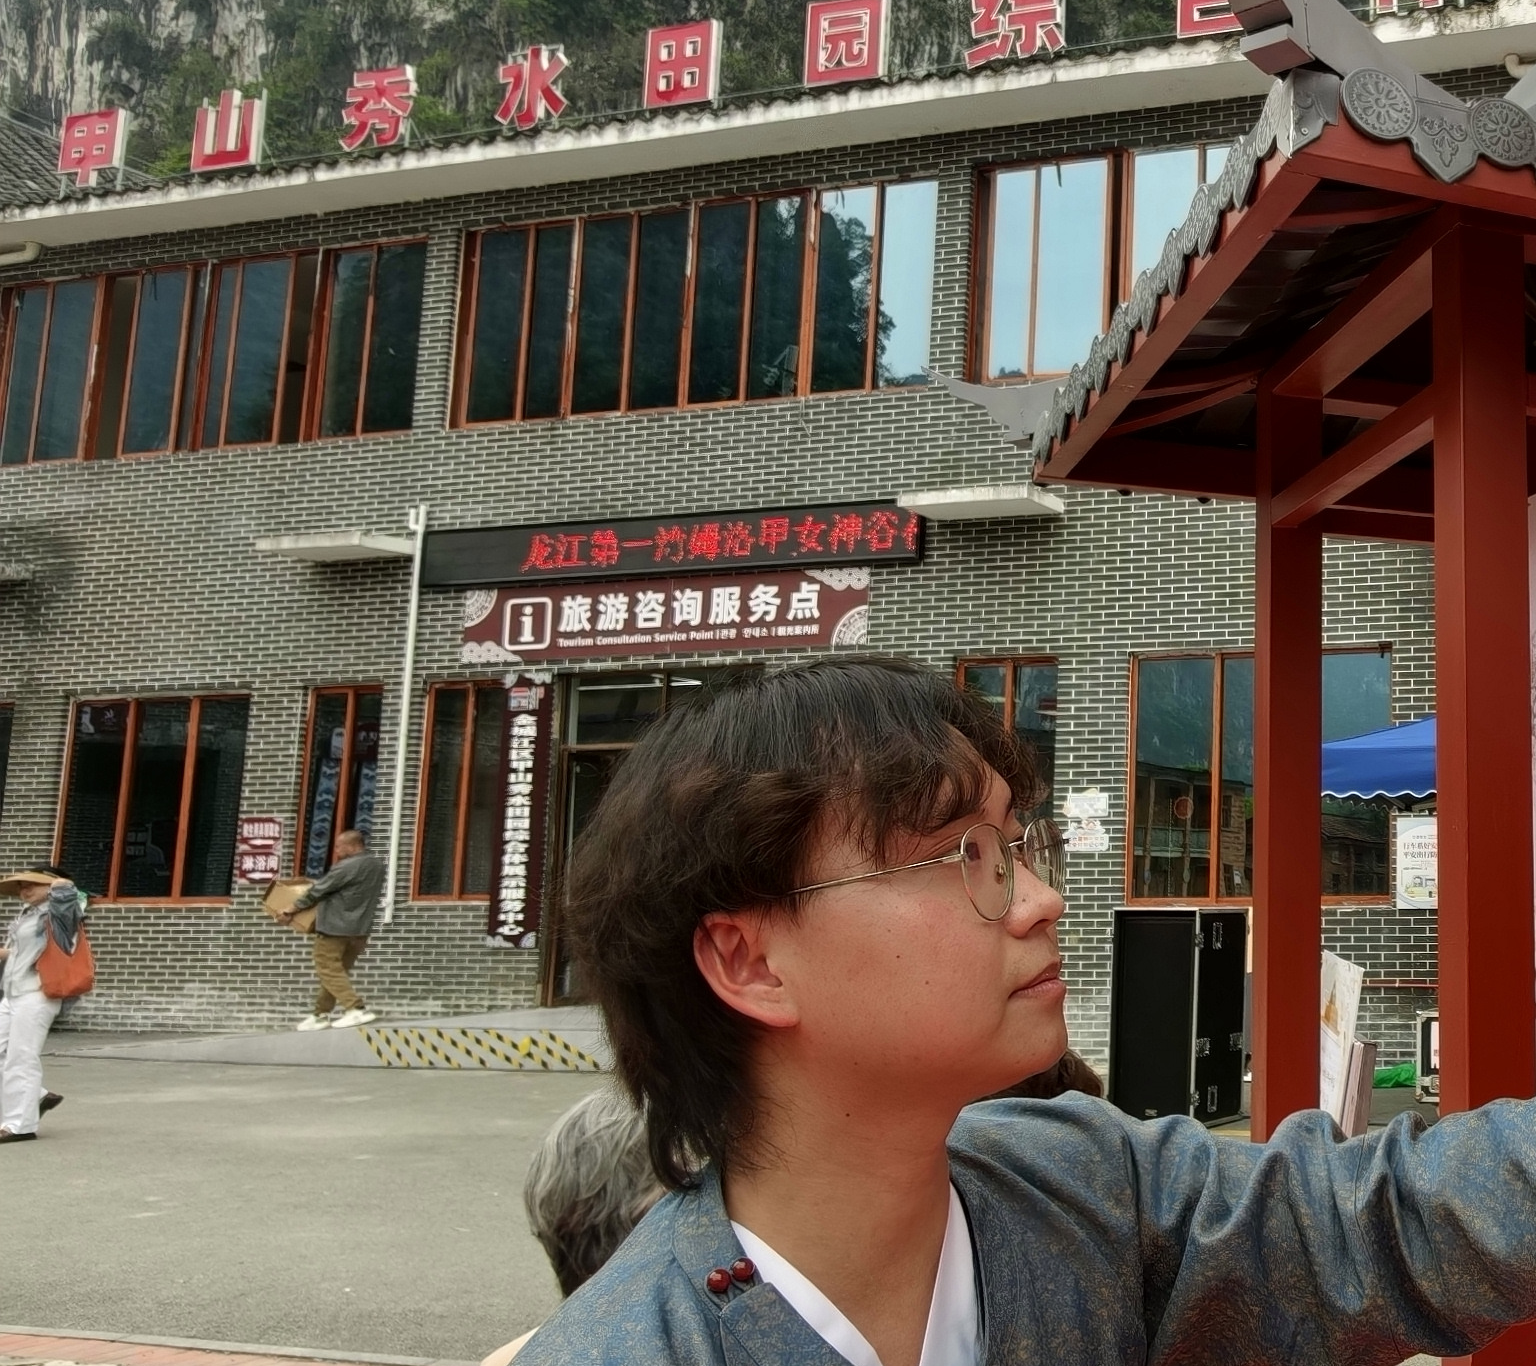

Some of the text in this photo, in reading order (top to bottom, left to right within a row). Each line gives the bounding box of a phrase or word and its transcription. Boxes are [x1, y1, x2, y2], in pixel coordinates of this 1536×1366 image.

[557, 581, 821, 633] 旅游咨询服务点
[557, 630, 714, 648] Tourism Consultation Service Point
